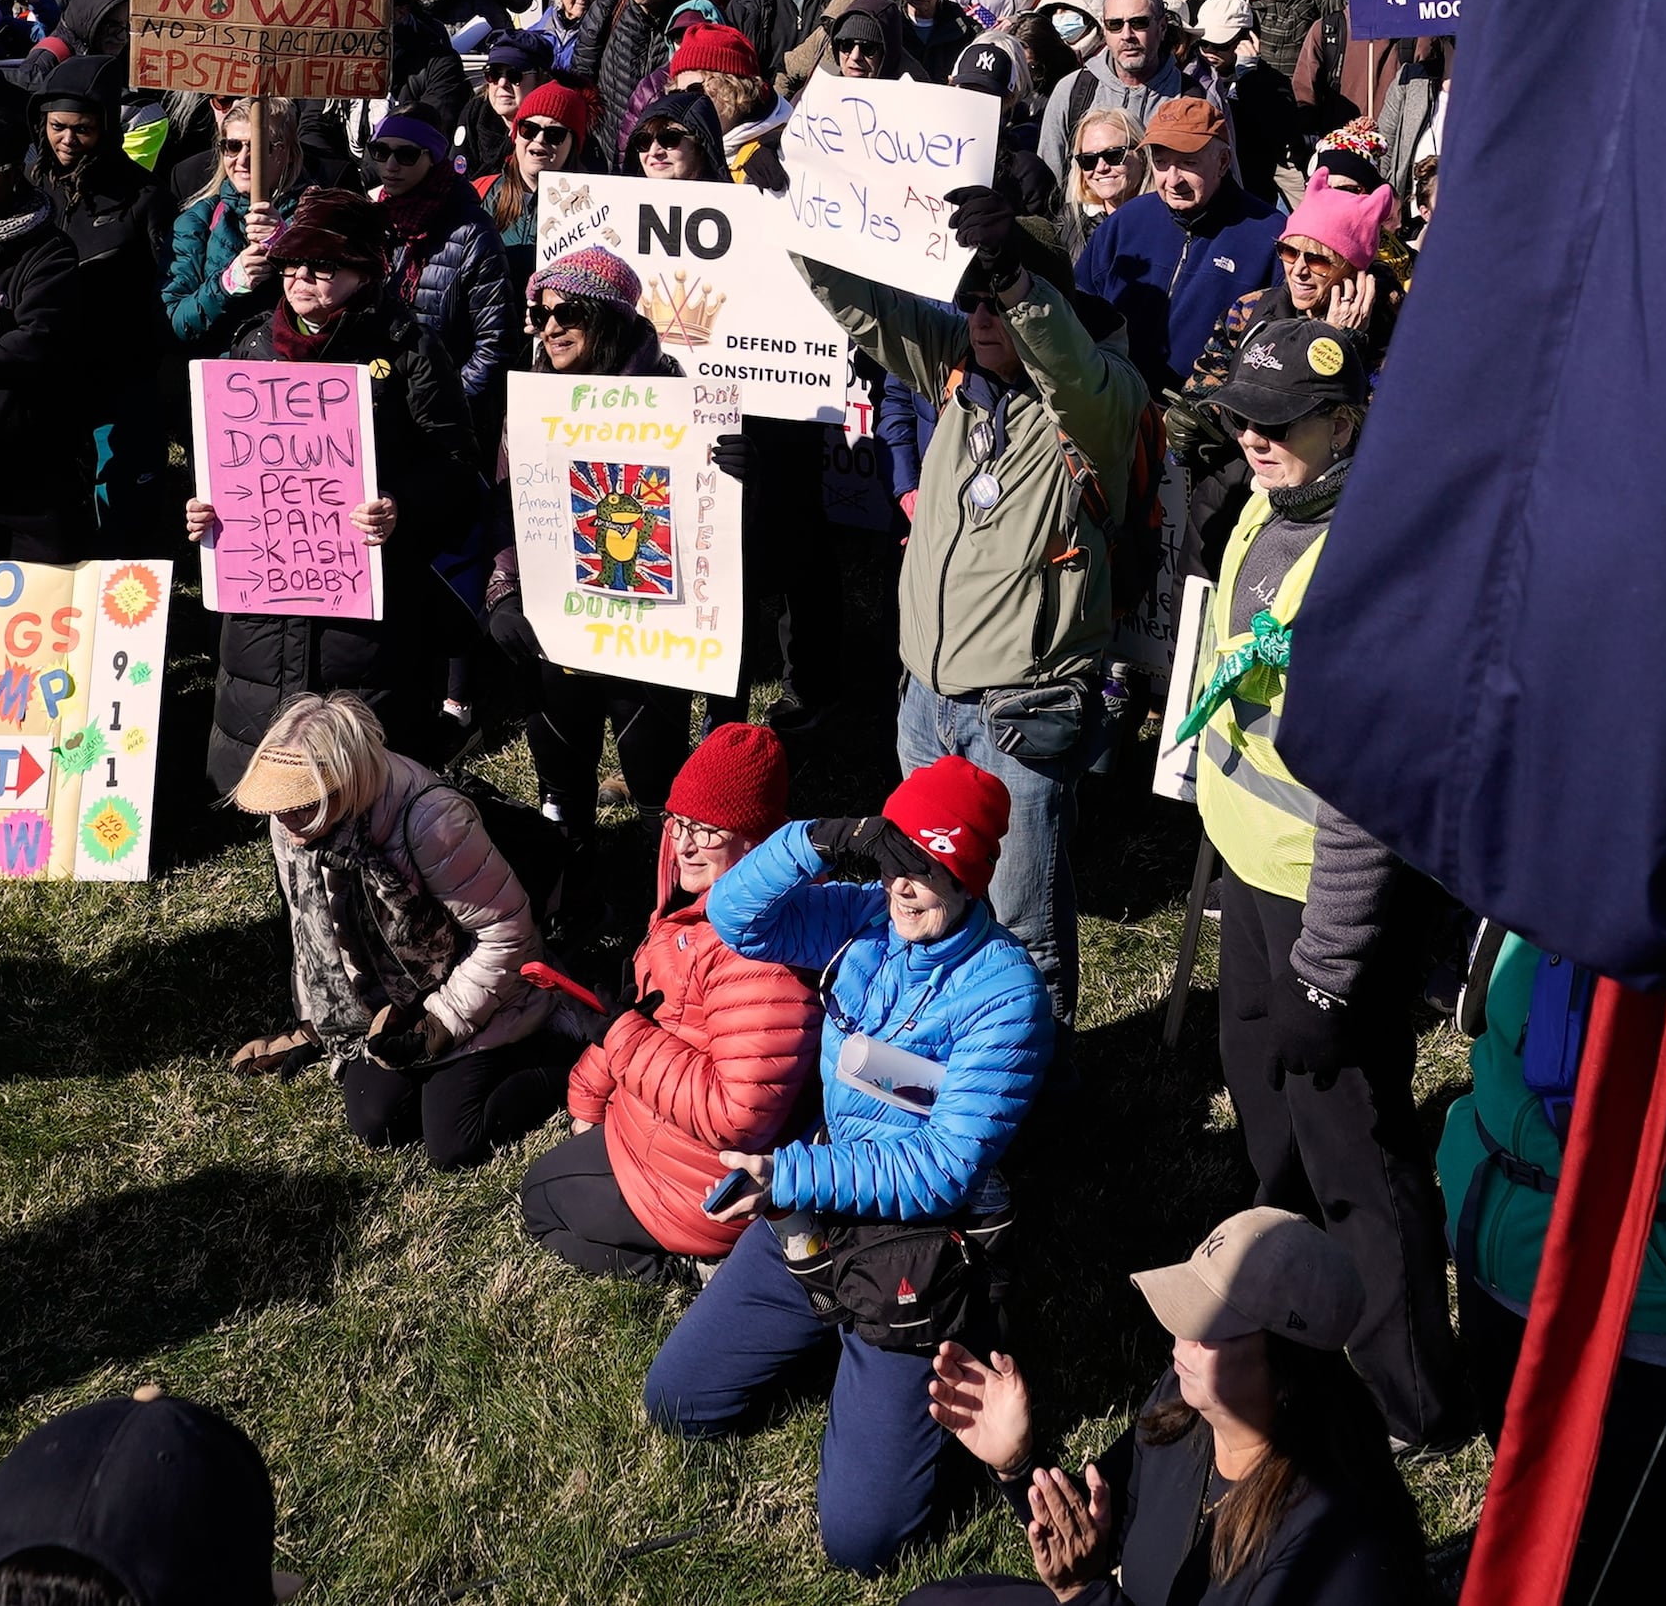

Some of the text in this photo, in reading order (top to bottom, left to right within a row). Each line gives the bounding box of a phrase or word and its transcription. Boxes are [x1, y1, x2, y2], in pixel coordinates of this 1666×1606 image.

[1419, 0, 1461, 20] MO
[141, 18, 390, 56] NO DISTRACTIONS
[138, 47, 392, 96] EPSTEIN FILES
[229, 52, 277, 67] FROM
[789, 94, 976, 167] ake Power
[788, 171, 901, 242] Vote Yes
[542, 205, 611, 262] WAKE-UP
[637, 204, 733, 260] NO
[925, 232, 949, 261] 21
[726, 336, 838, 358] DEFEND THE
[698, 362, 831, 388] CONSTITUTION
[223, 373, 350, 421] STEP
[572, 385, 659, 411] Fight
[693, 385, 739, 405] Don't
[541, 417, 687, 449] Tyranny
[221, 428, 355, 470] DOWN
[516, 463, 560, 485] 25th
[260, 473, 345, 507] PETE
[518, 492, 561, 510] Amend
[263, 509, 340, 540] PAM
[528, 514, 563, 529] ment
[524, 531, 543, 542] Art
[693, 443, 720, 632] IMPEACH
[265, 539, 357, 566] KASH
[267, 568, 363, 594] BOBBY
[564, 591, 656, 623] DUMP
[584, 623, 723, 672] TRUMP
[95, 820, 119, 843] ICE
[104, 815, 121, 832] NO
